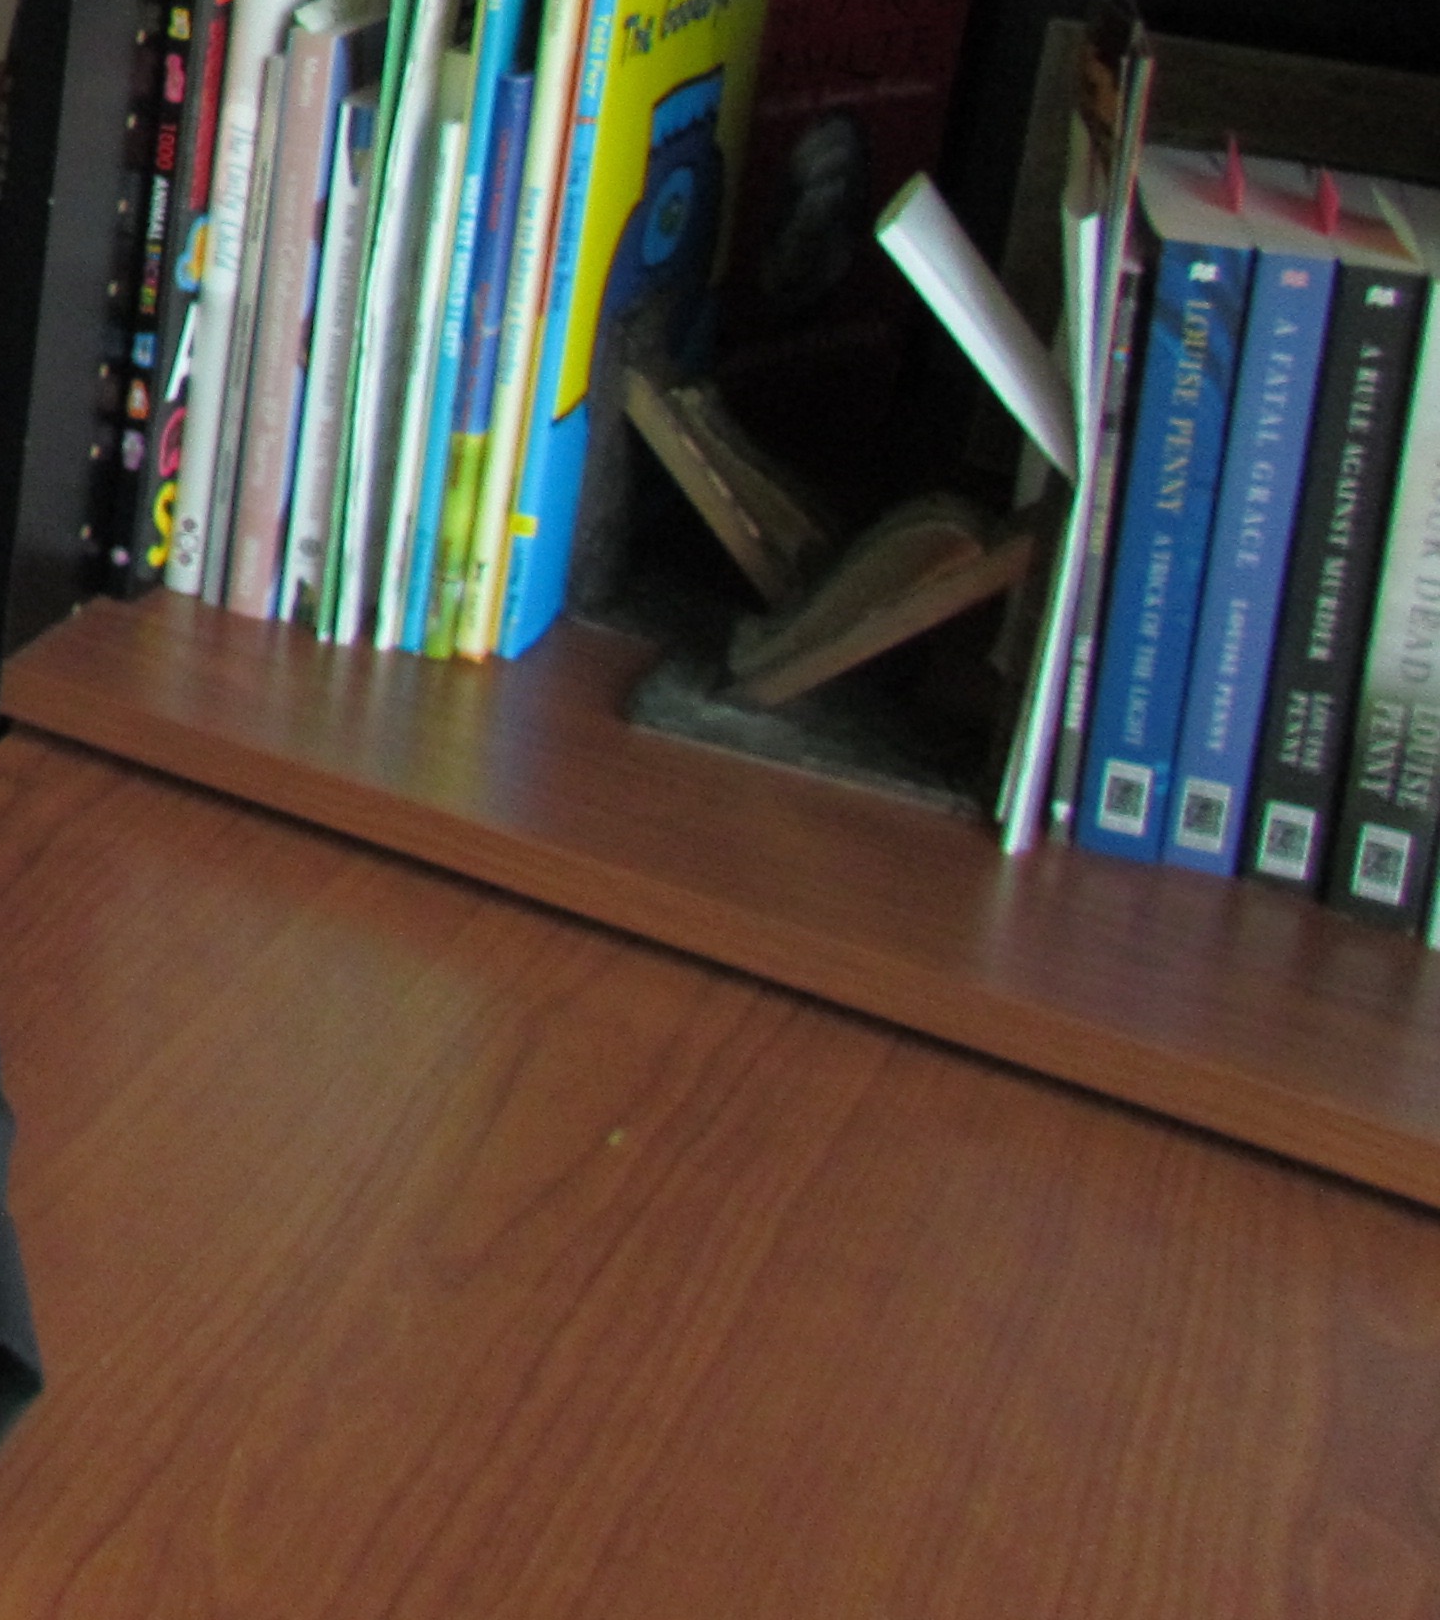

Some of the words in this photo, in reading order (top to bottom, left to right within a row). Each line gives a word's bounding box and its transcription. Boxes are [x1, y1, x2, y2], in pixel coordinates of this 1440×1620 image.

[591, 14, 612, 53] Todd
[584, 59, 606, 98] Parr
[156, 124, 177, 171] 1000
[146, 174, 169, 240] ANIMAL
[1172, 299, 1213, 406] LOUISE
[1273, 317, 1298, 336] A
[1359, 341, 1383, 359] A
[1255, 352, 1295, 445] FATAL
[1348, 366, 1379, 432] RULE
[1156, 417, 1195, 515] PENNY
[1326, 442, 1364, 548] AGAINST
[1154, 534, 1174, 546] A
[1235, 461, 1273, 569] GRACE
[1143, 551, 1173, 608] TRICK
[1307, 556, 1347, 661] MURDER
[1140, 611, 1160, 640] OF
[1219, 598, 1248, 676] LOUISE
[1206, 682, 1232, 751] PENNY
[1279, 690, 1309, 765] PENNY
[1300, 691, 1333, 771] LOUISE
[1361, 701, 1405, 801] PENNY
[1396, 704, 1440, 810] LOUISE
